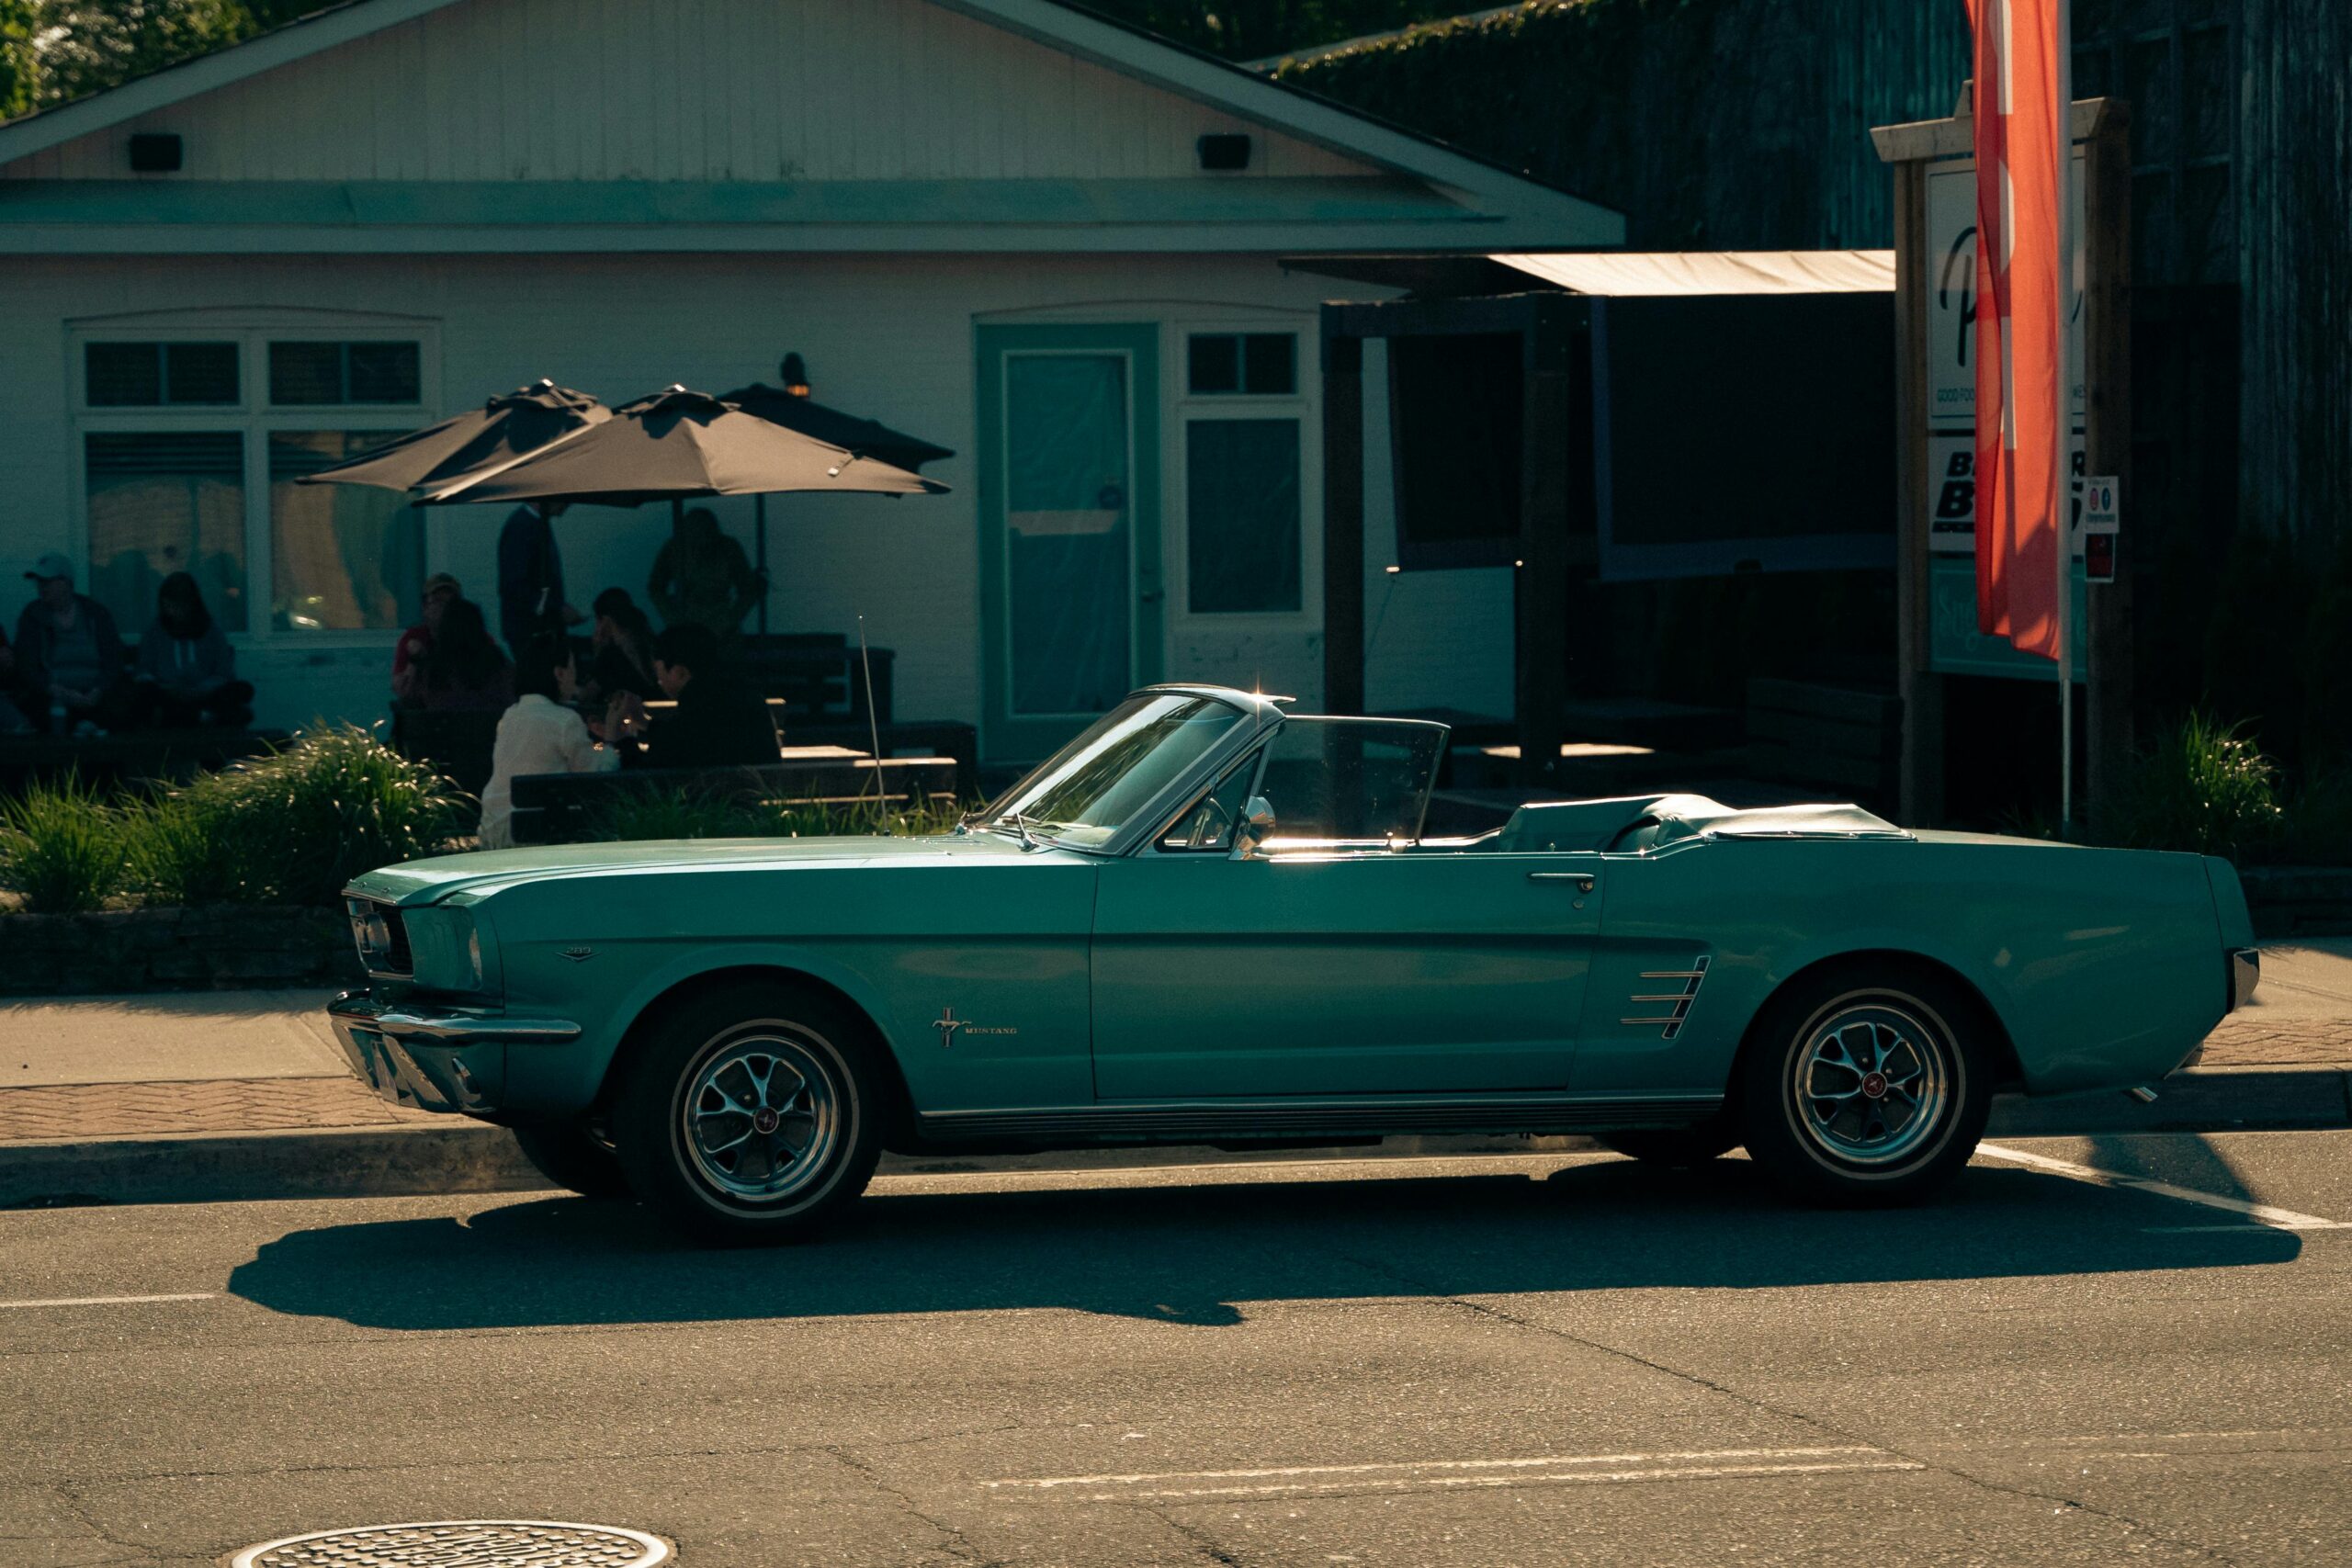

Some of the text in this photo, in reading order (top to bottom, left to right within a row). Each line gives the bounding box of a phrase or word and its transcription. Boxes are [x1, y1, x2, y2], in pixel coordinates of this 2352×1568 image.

[1960, 388, 1974, 401] FOO
[566, 946, 591, 954] 289
[436, 1534, 584, 1567] STORM
